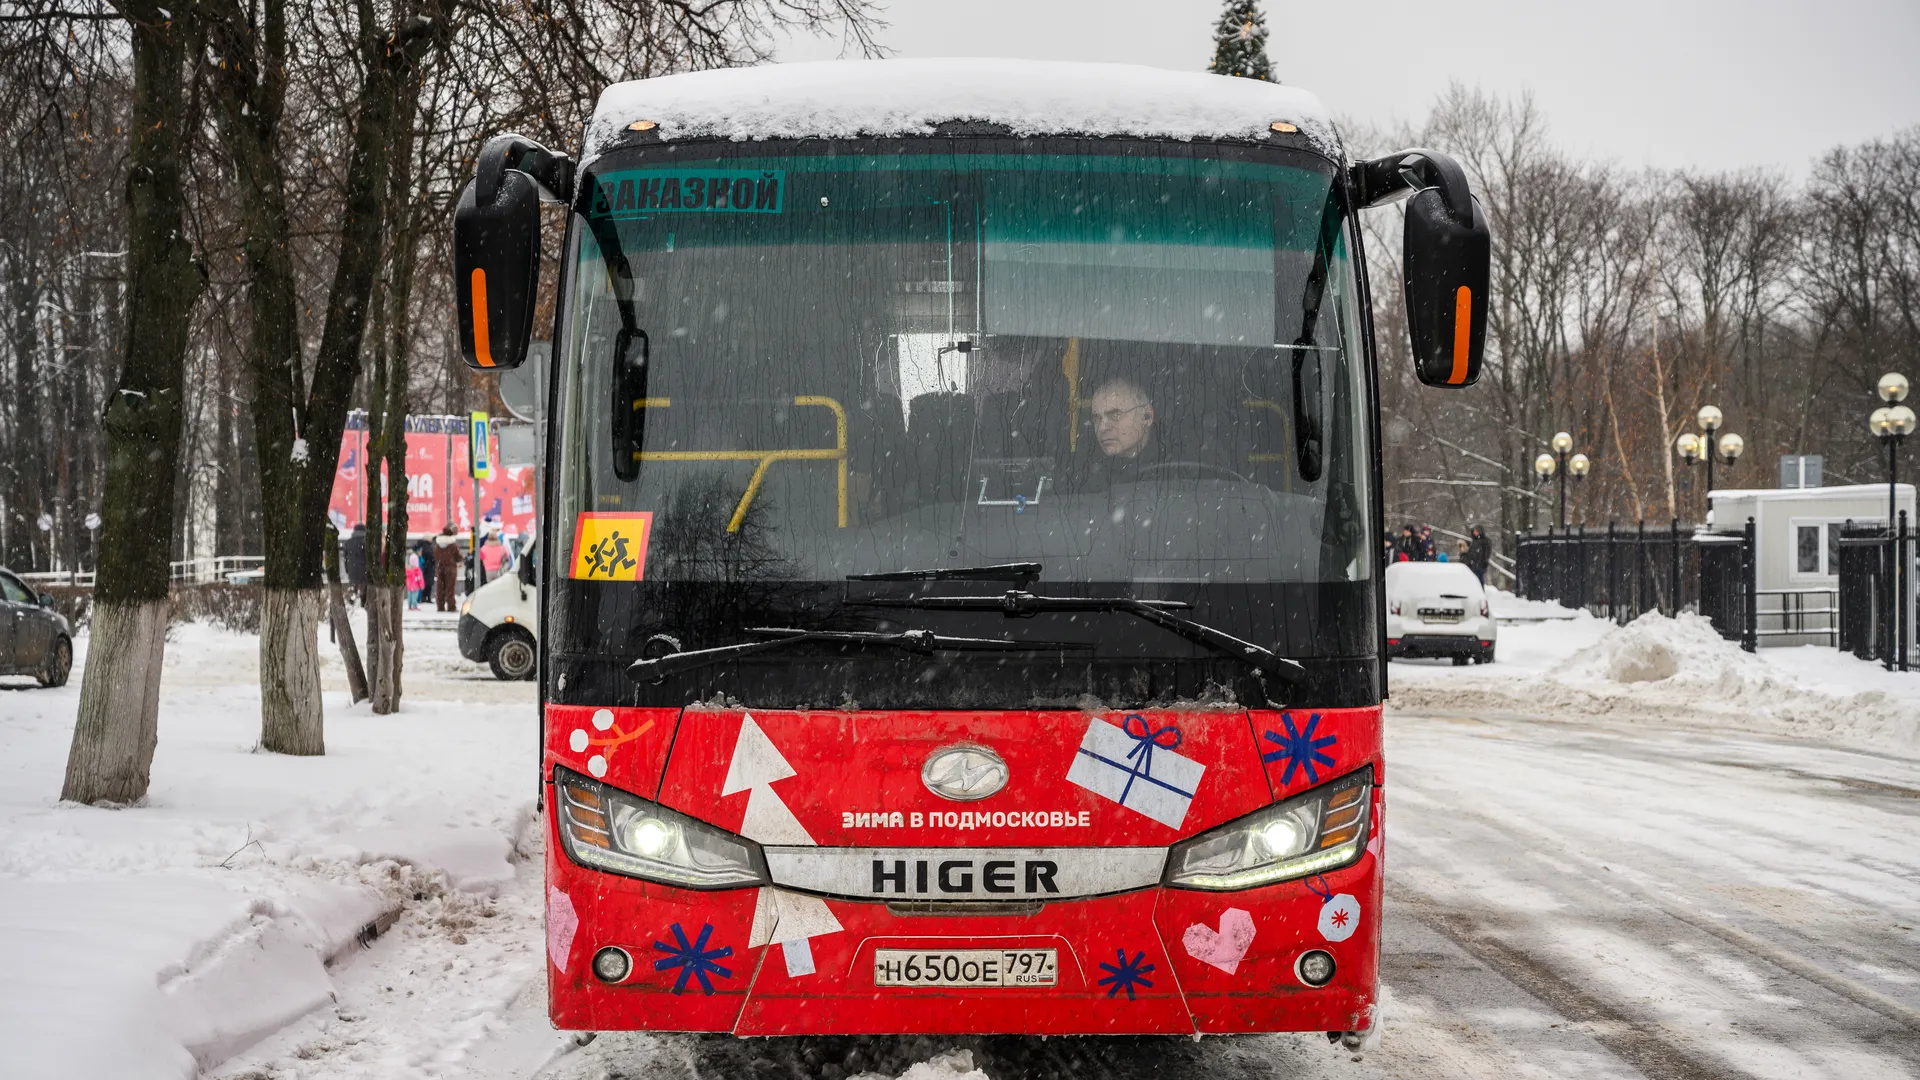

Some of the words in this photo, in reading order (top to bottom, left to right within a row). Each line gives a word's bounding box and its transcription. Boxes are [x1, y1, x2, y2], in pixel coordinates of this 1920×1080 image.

[596, 172, 778, 214] ЗАКАЗНОЙ
[842, 811, 904, 828] ЗИМА
[909, 811, 924, 828] В
[929, 810, 1091, 830] ПОДМОСКОВЬЕ
[872, 860, 1060, 893] HIGER
[1004, 953, 1048, 974] 797
[1015, 975, 1038, 983] RUS
